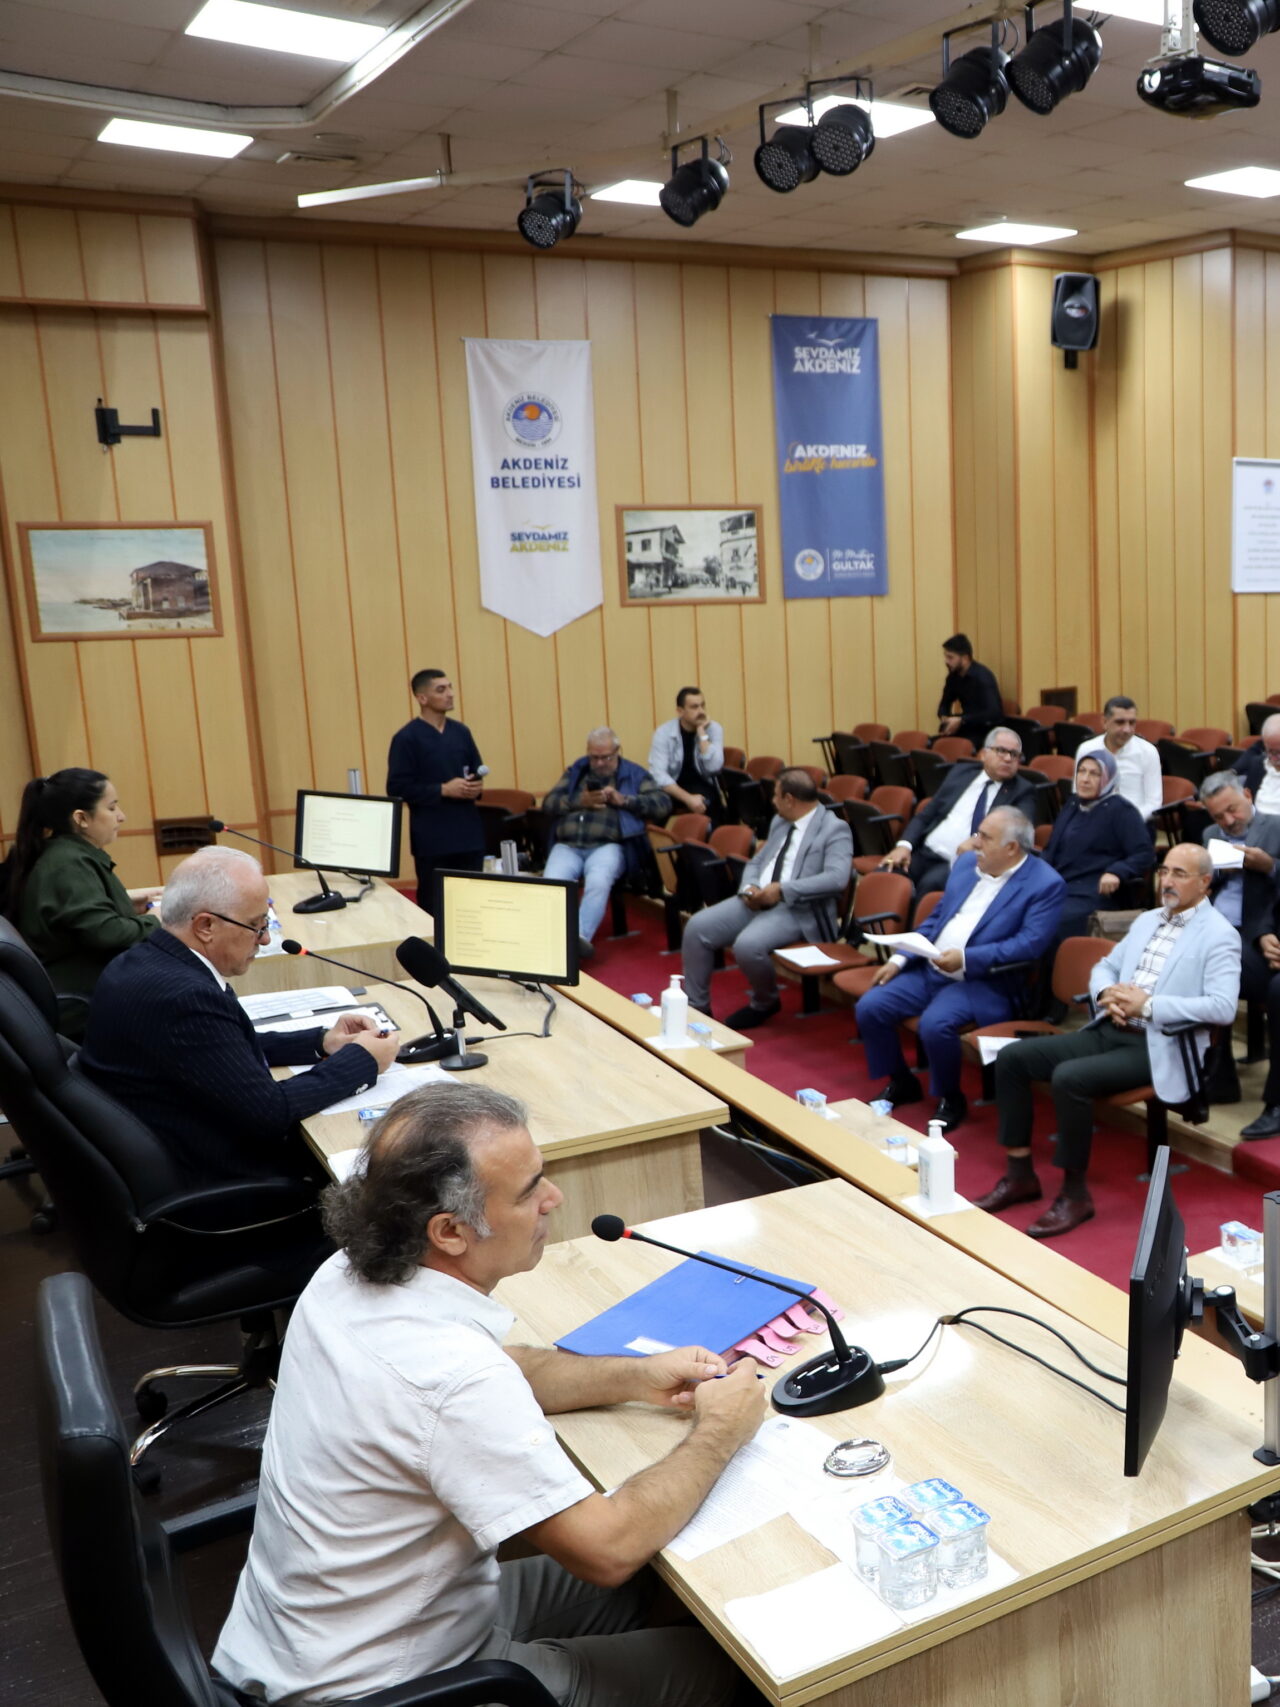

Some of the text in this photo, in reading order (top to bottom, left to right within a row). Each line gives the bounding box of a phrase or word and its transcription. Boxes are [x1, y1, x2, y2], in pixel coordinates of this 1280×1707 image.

[793, 346, 861, 359] SEVDAMIZ
[500, 453, 569, 470] AKDENİZ
[490, 471, 581, 489] BELEDİYESİ
[510, 531, 569, 541] SEVDAMIZ
